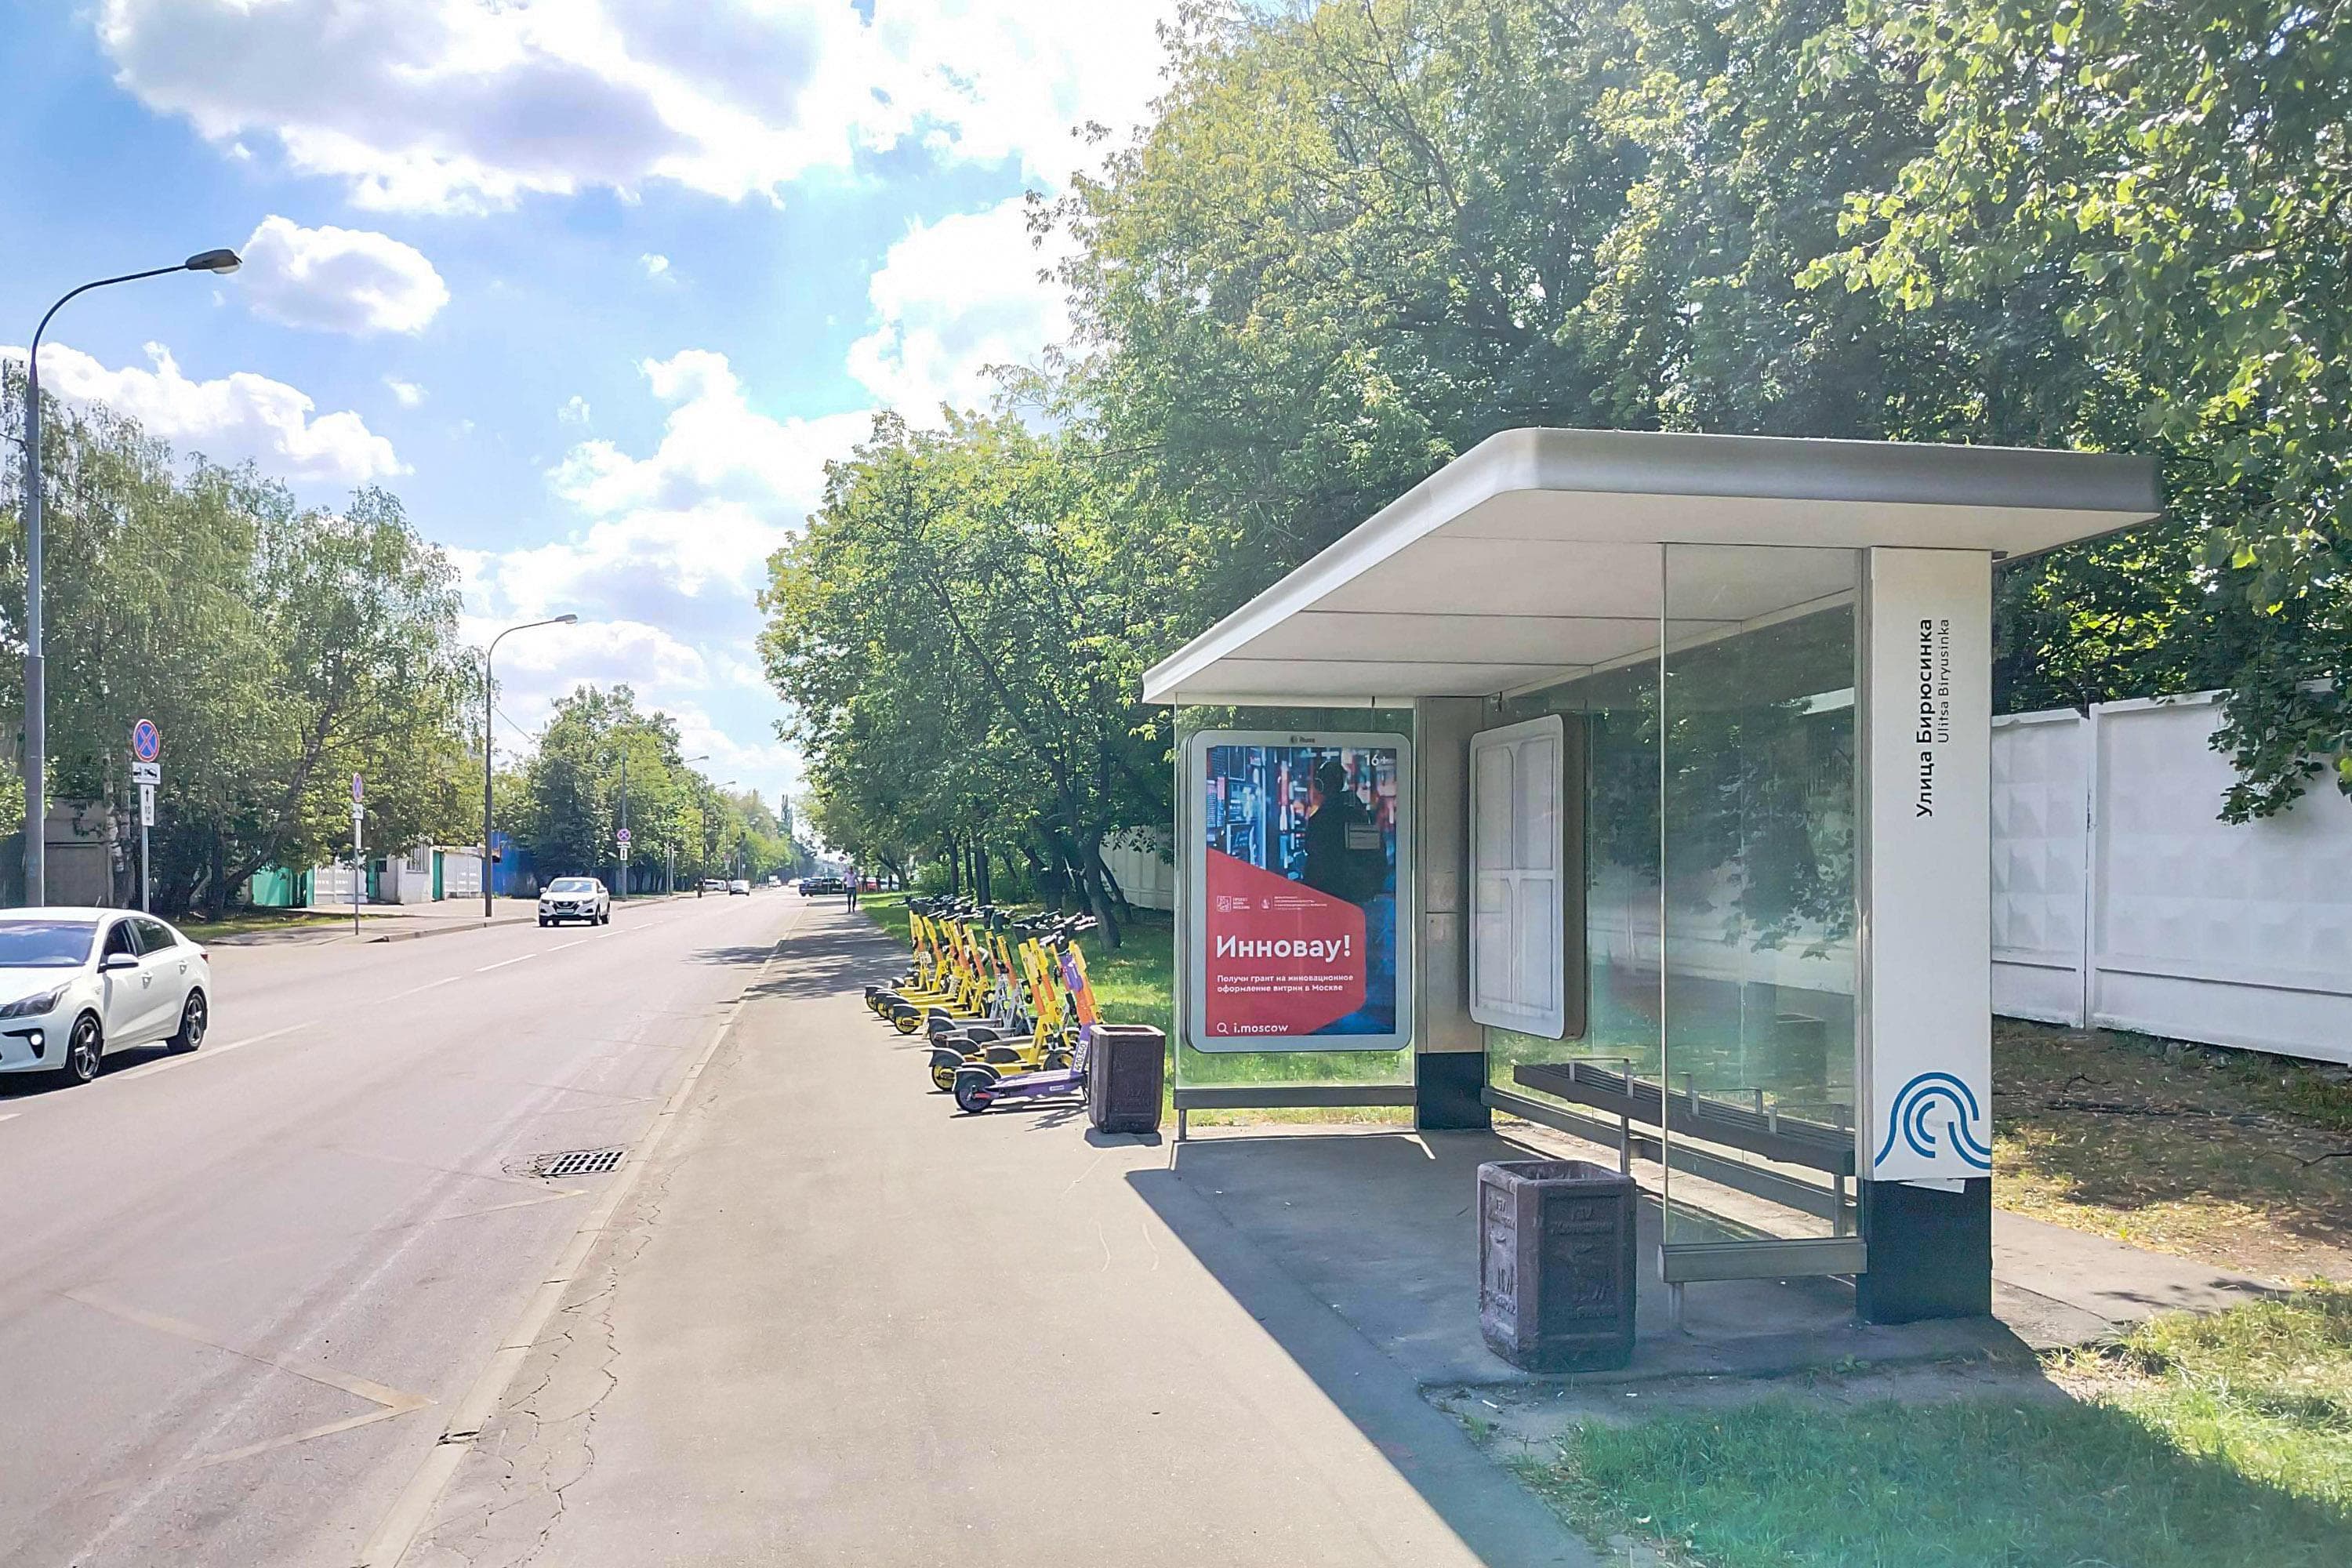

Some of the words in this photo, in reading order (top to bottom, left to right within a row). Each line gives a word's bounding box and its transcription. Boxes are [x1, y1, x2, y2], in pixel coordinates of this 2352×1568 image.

[1937, 619, 1951, 696] Biryusinka
[1916, 619, 1935, 743] Бирюсинка
[1937, 701, 1949, 743] Ulitsa
[1364, 753, 1389, 766] 16+
[1916, 751, 1934, 817] Улица
[1216, 935, 1351, 964] Инновау!
[1217, 975, 1249, 984] Получи
[1250, 975, 1275, 983] грант
[1217, 985, 1271, 993] оформление
[1233, 1022, 1289, 1033] i.moscow
